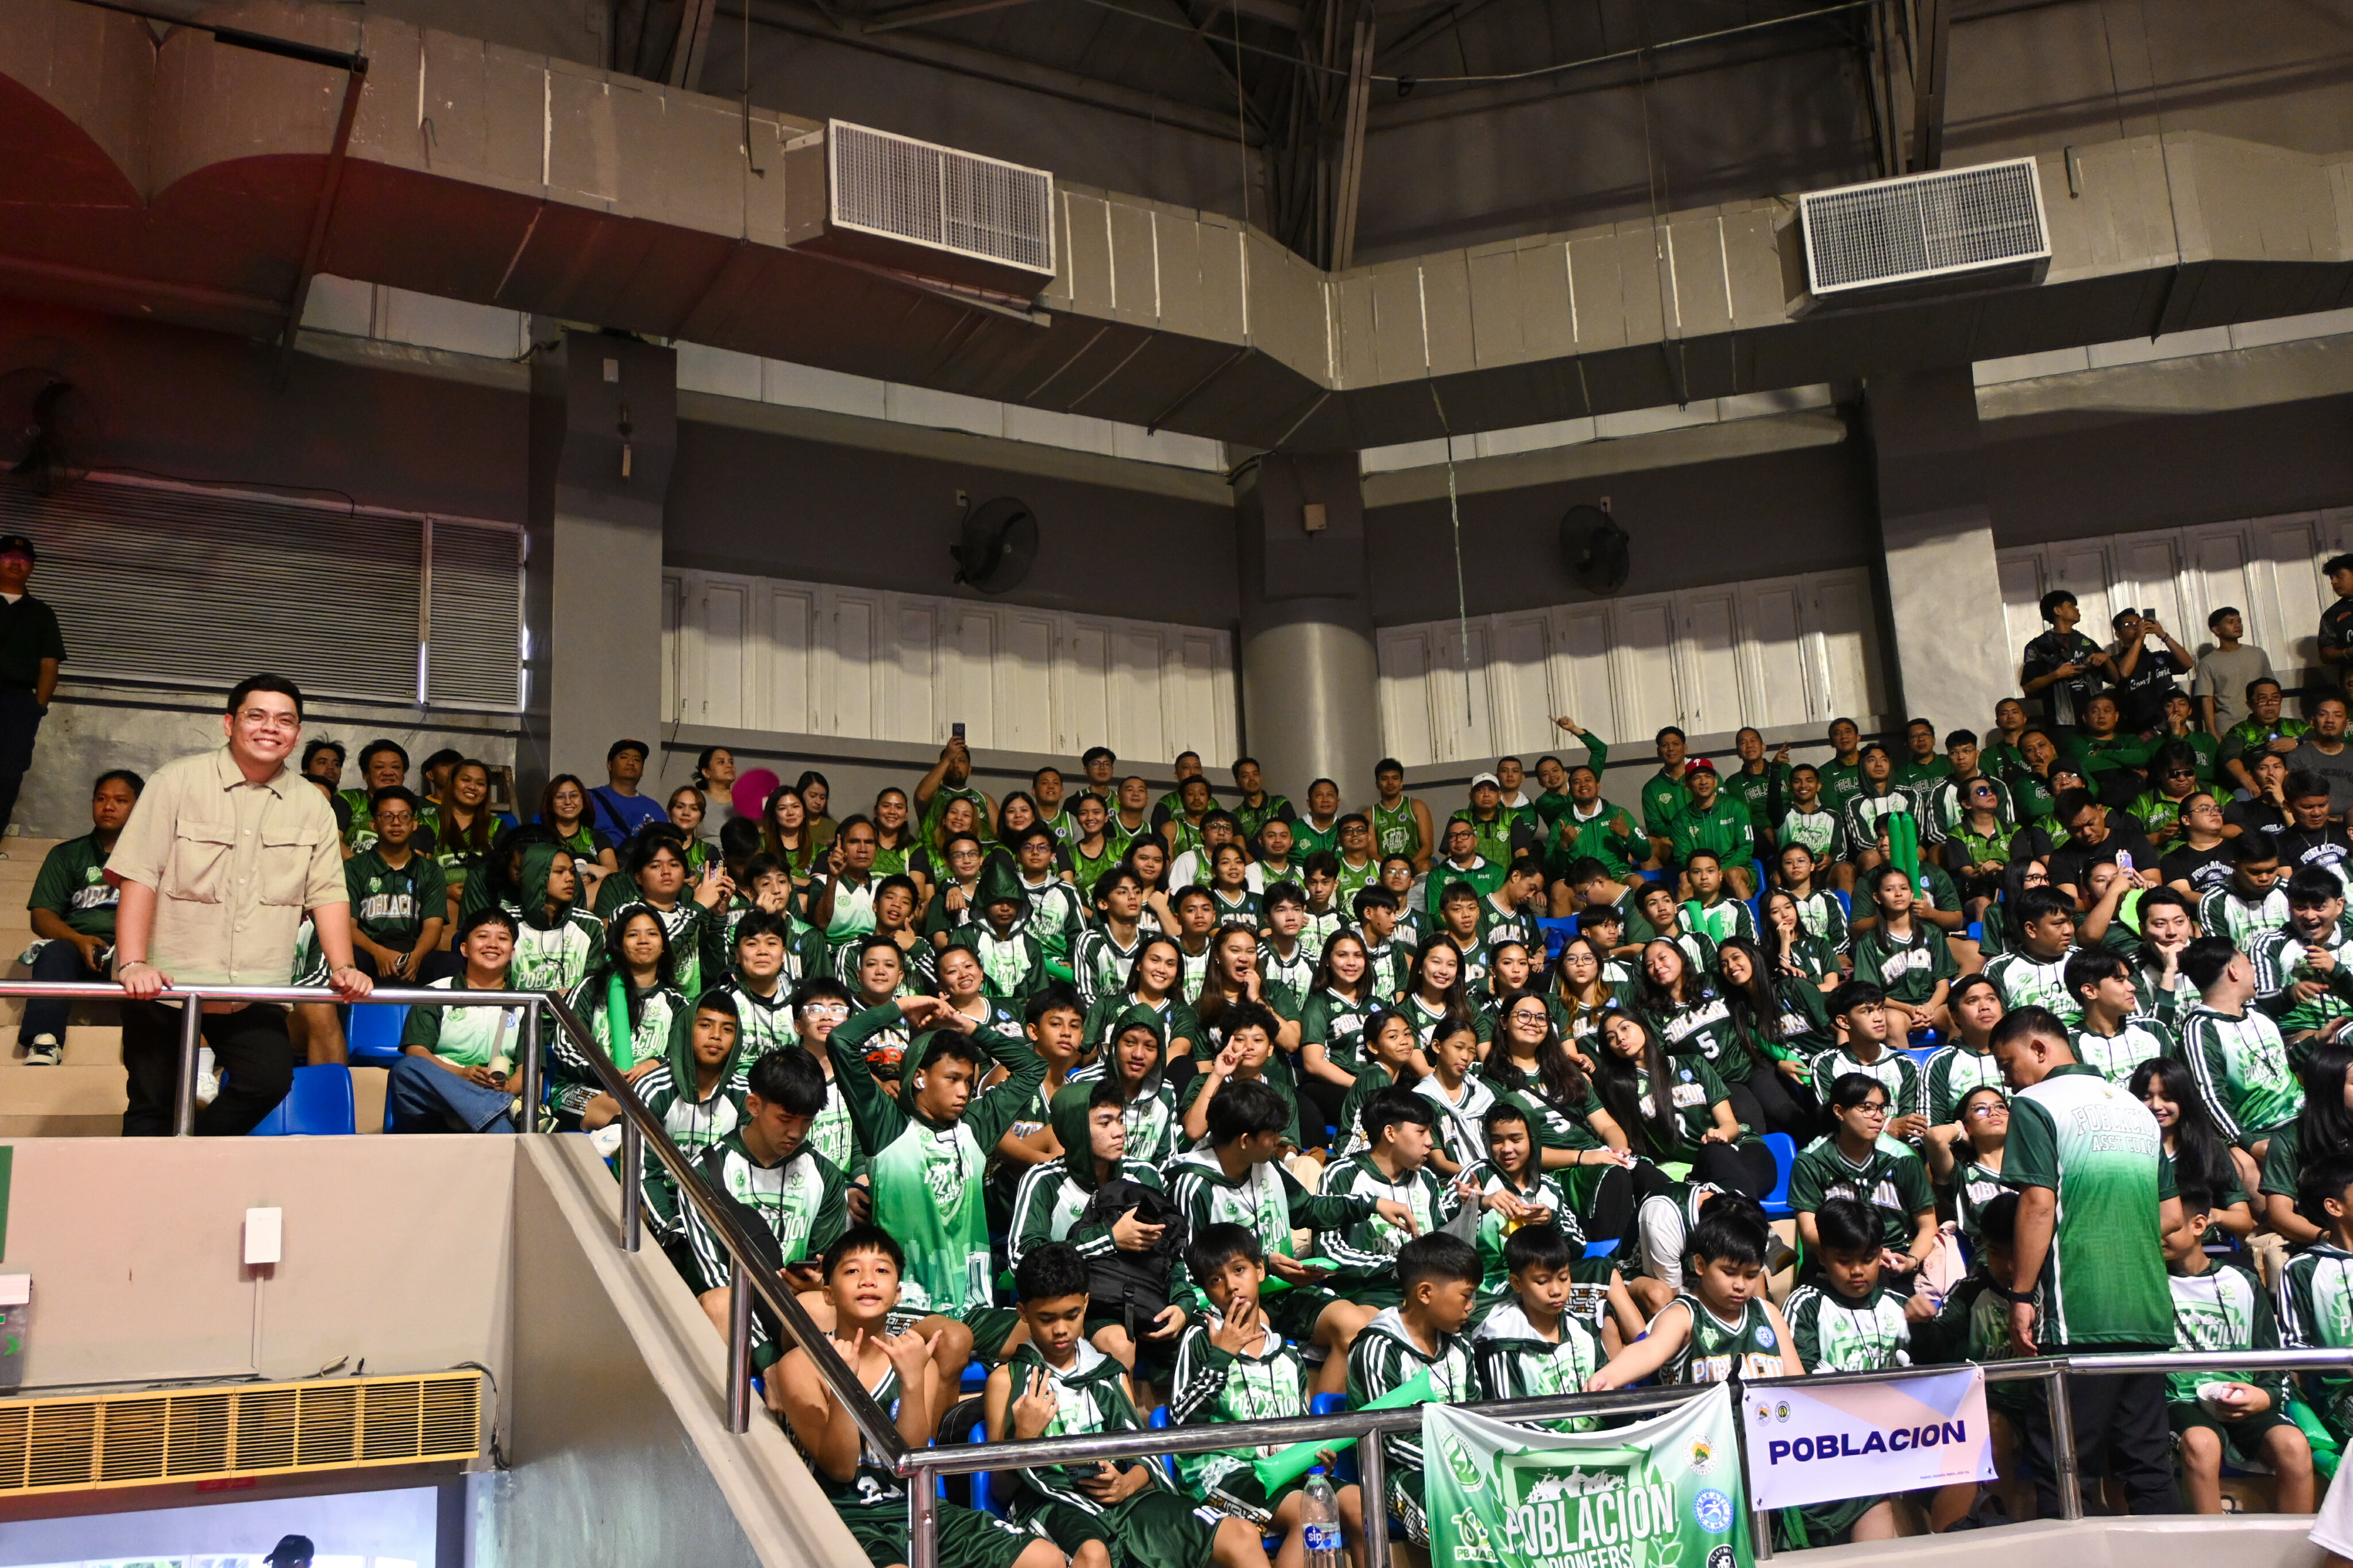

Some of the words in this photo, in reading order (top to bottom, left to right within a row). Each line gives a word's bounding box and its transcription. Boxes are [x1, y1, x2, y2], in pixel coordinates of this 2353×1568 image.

[1634, 827, 1647, 840] 8
[2300, 843, 2348, 864] POBLACION
[1695, 1030, 1720, 1059] 5
[2092, 1134, 2124, 1152] ASST
[2174, 1323, 2249, 1346] LACION
[1692, 1351, 1784, 1383] POBACIO
[1457, 1436, 1475, 1463] KABATAA
[1769, 1420, 1966, 1465] POBLACION
[1697, 1493, 1727, 1508] MAKATI
[1505, 1483, 1674, 1556] POBLACION
[1701, 1513, 1730, 1528] GAMES
[1308, 1529, 1322, 1544] sip
[1457, 1549, 1469, 1558] PB
[1471, 1548, 1496, 1560] JAR
[1710, 1547, 1733, 1563] CLAPMO
